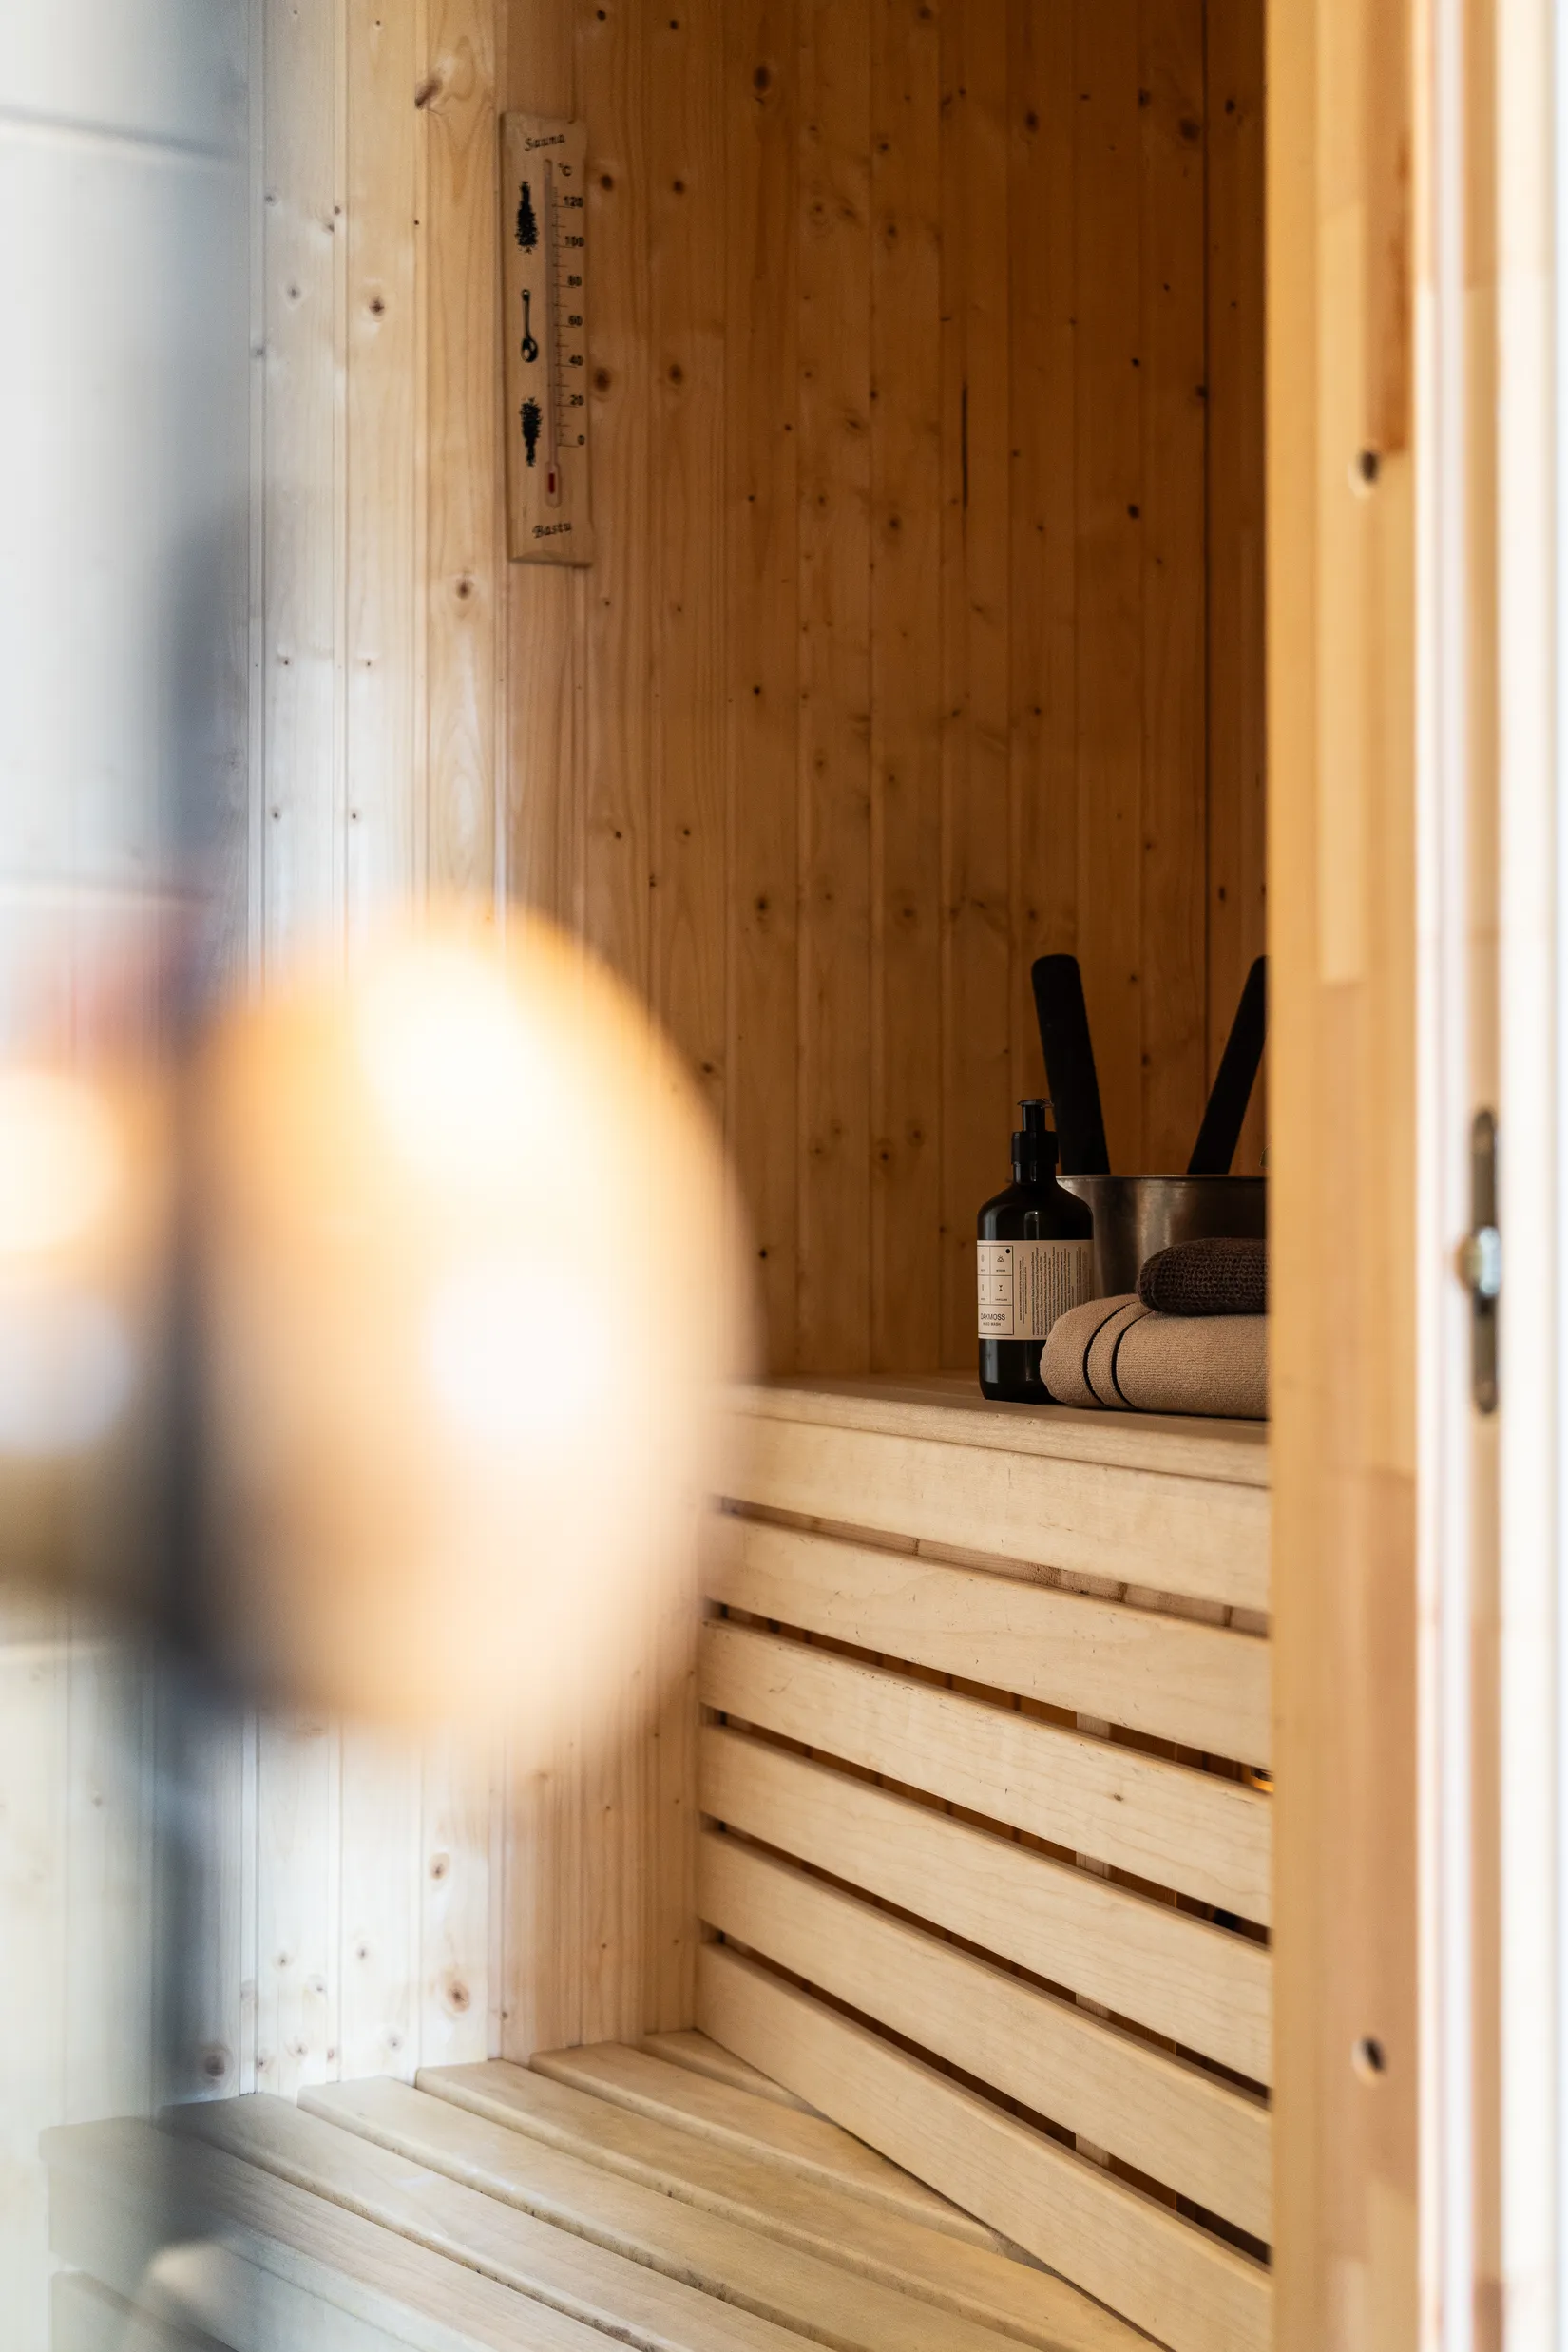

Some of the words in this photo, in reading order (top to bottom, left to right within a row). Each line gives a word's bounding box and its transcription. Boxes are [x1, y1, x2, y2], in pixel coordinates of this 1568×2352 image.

[524, 133, 566, 152] Sauna
[564, 196, 584, 207] 120
[564, 236, 585, 247] 100
[567, 275, 582, 286] 80
[568, 315, 583, 326] 60
[568, 354, 583, 366] 40
[570, 394, 584, 406] 20
[577, 435, 585, 446] 0
[531, 522, 572, 539] Bastu
